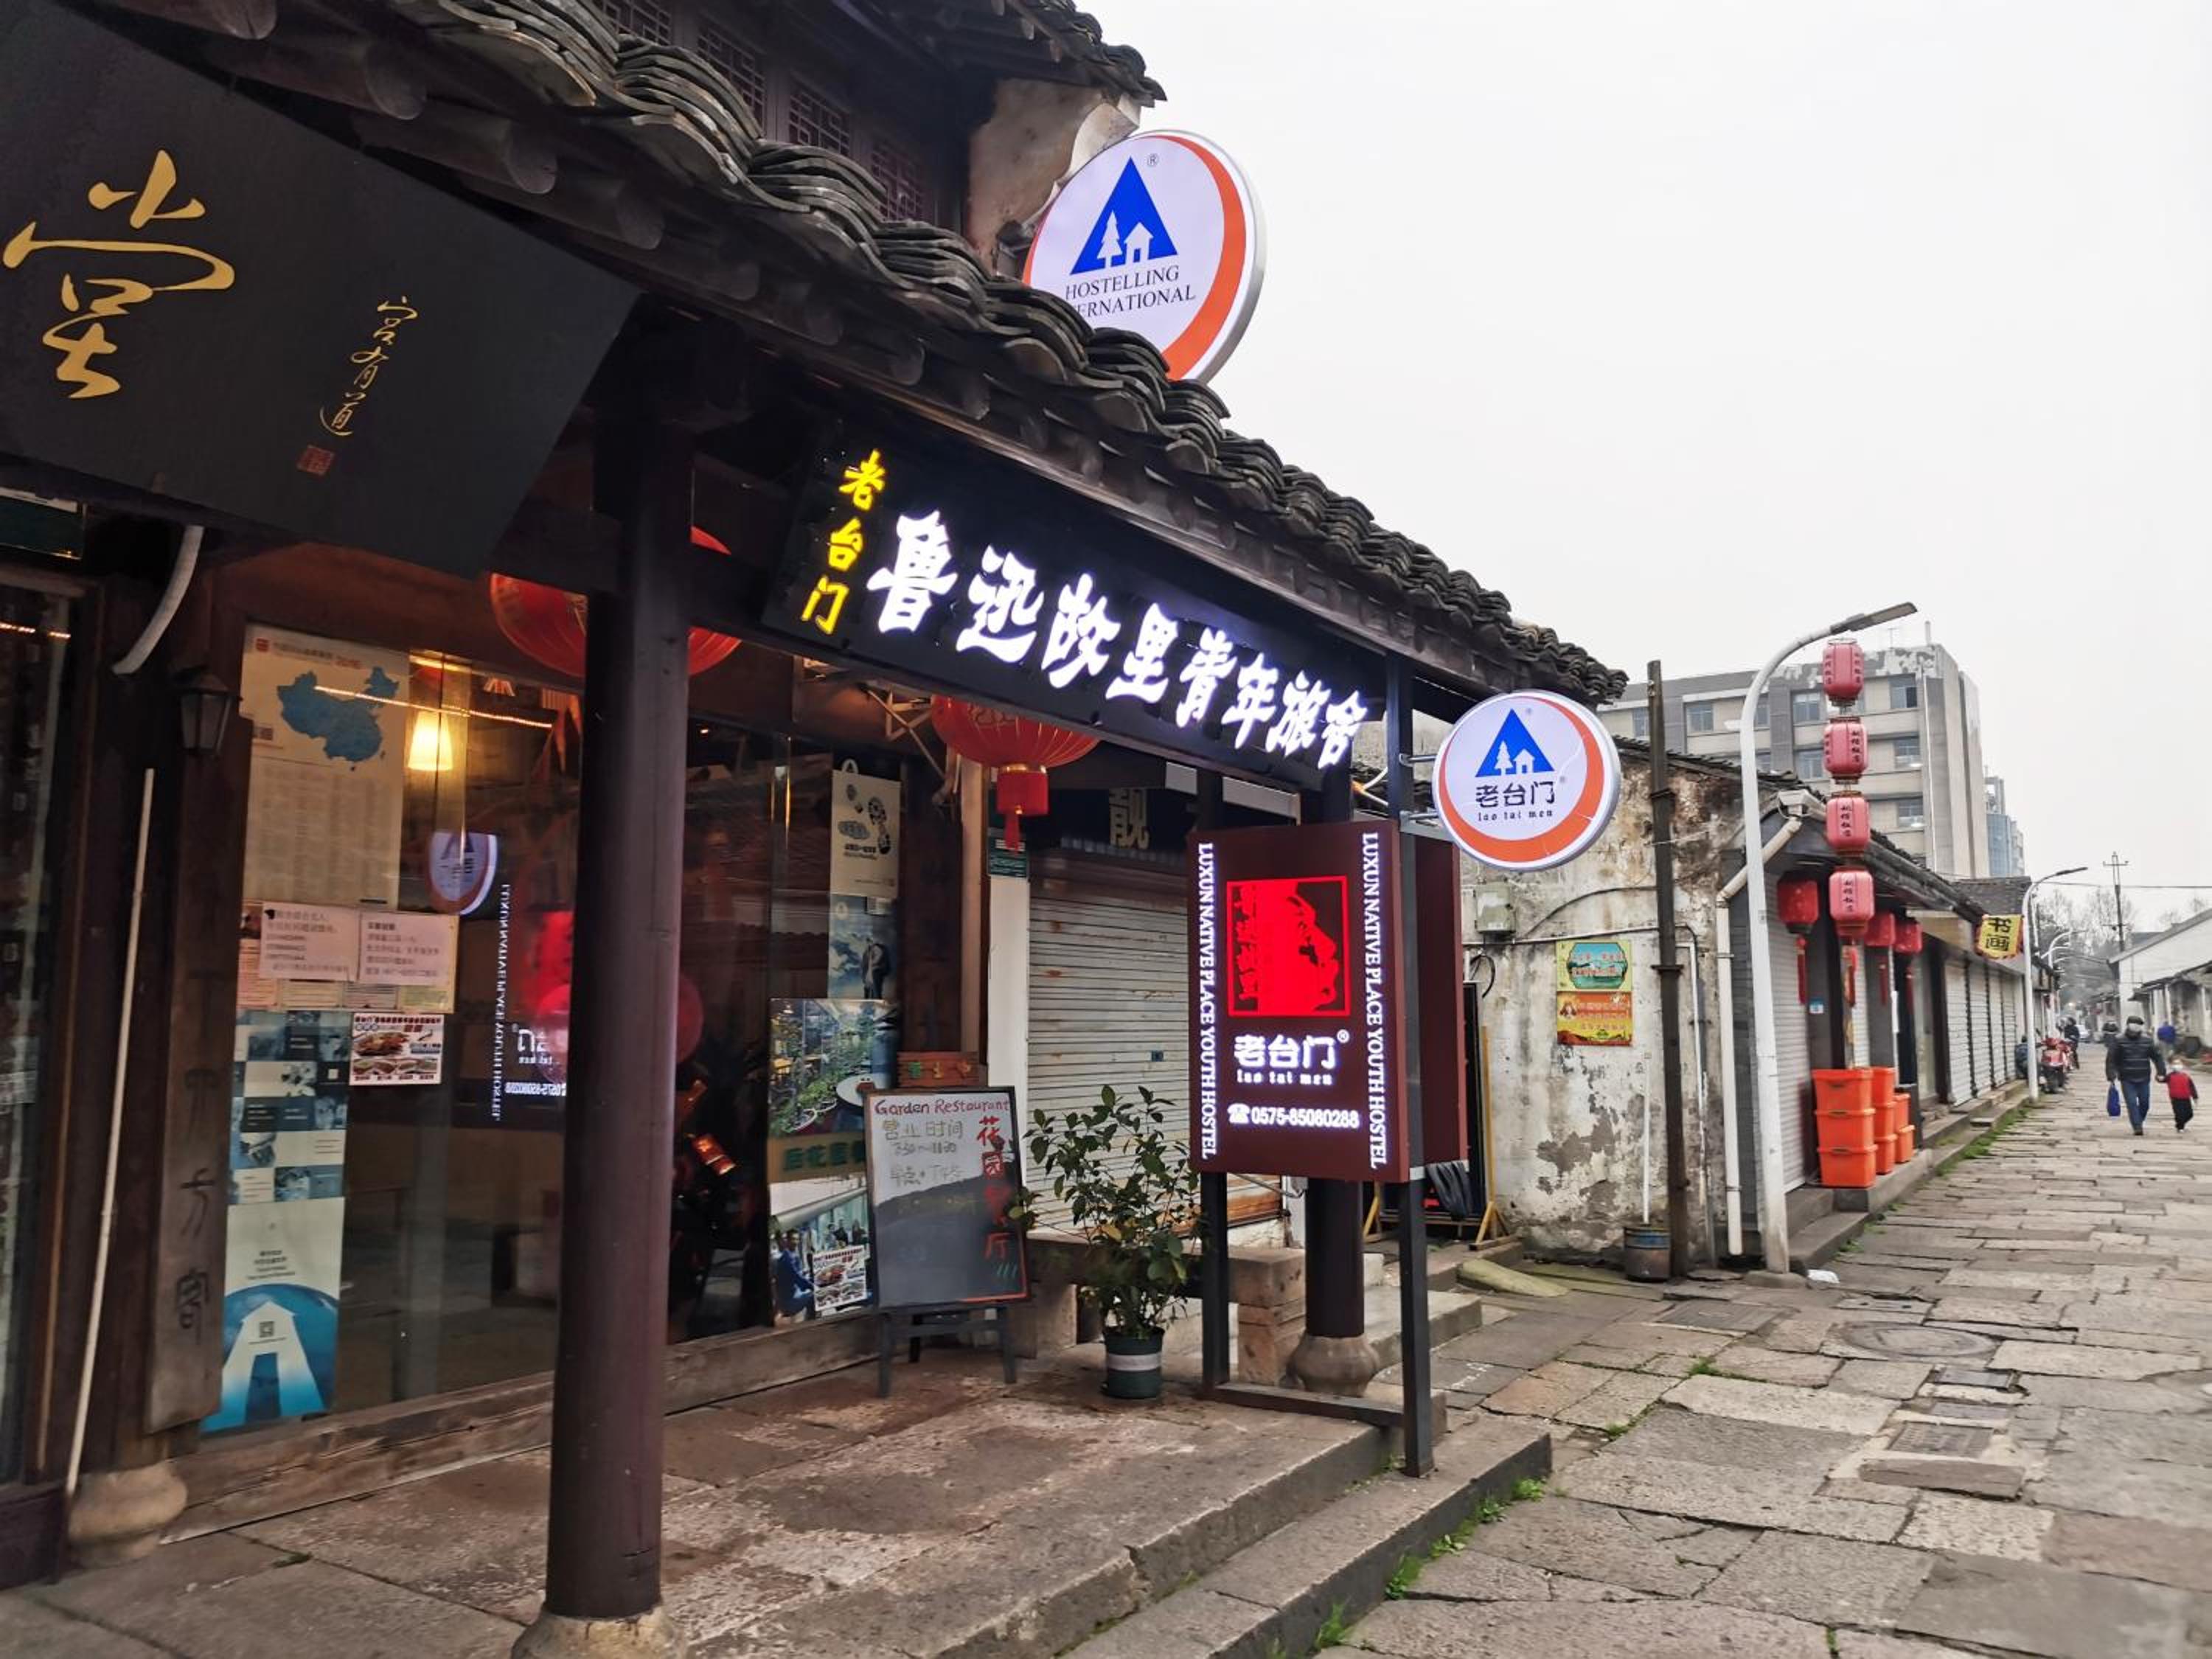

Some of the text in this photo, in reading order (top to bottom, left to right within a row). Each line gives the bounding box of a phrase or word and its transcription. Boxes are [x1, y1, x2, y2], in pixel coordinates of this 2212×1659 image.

[1065, 265, 1180, 301] HOSTELLING
[1075, 285, 1196, 319] ERNATIONAL
[800, 449, 886, 635] 老台门
[866, 509, 1368, 768] 鲁迅故里青年旅舍
[1475, 781, 1554, 808] 老台门
[1198, 843, 1217, 1160] LUXUN NATIVE PLACE YOUTH HOSTEL
[1362, 832, 1387, 1169] LUXUN NATIVE PLACE YOUTH HOSTEL
[1234, 1034, 1336, 1069] 老台门
[874, 1099, 1010, 1115] Garden Restaurant
[1251, 1107, 1360, 1129] 0575-85080288
